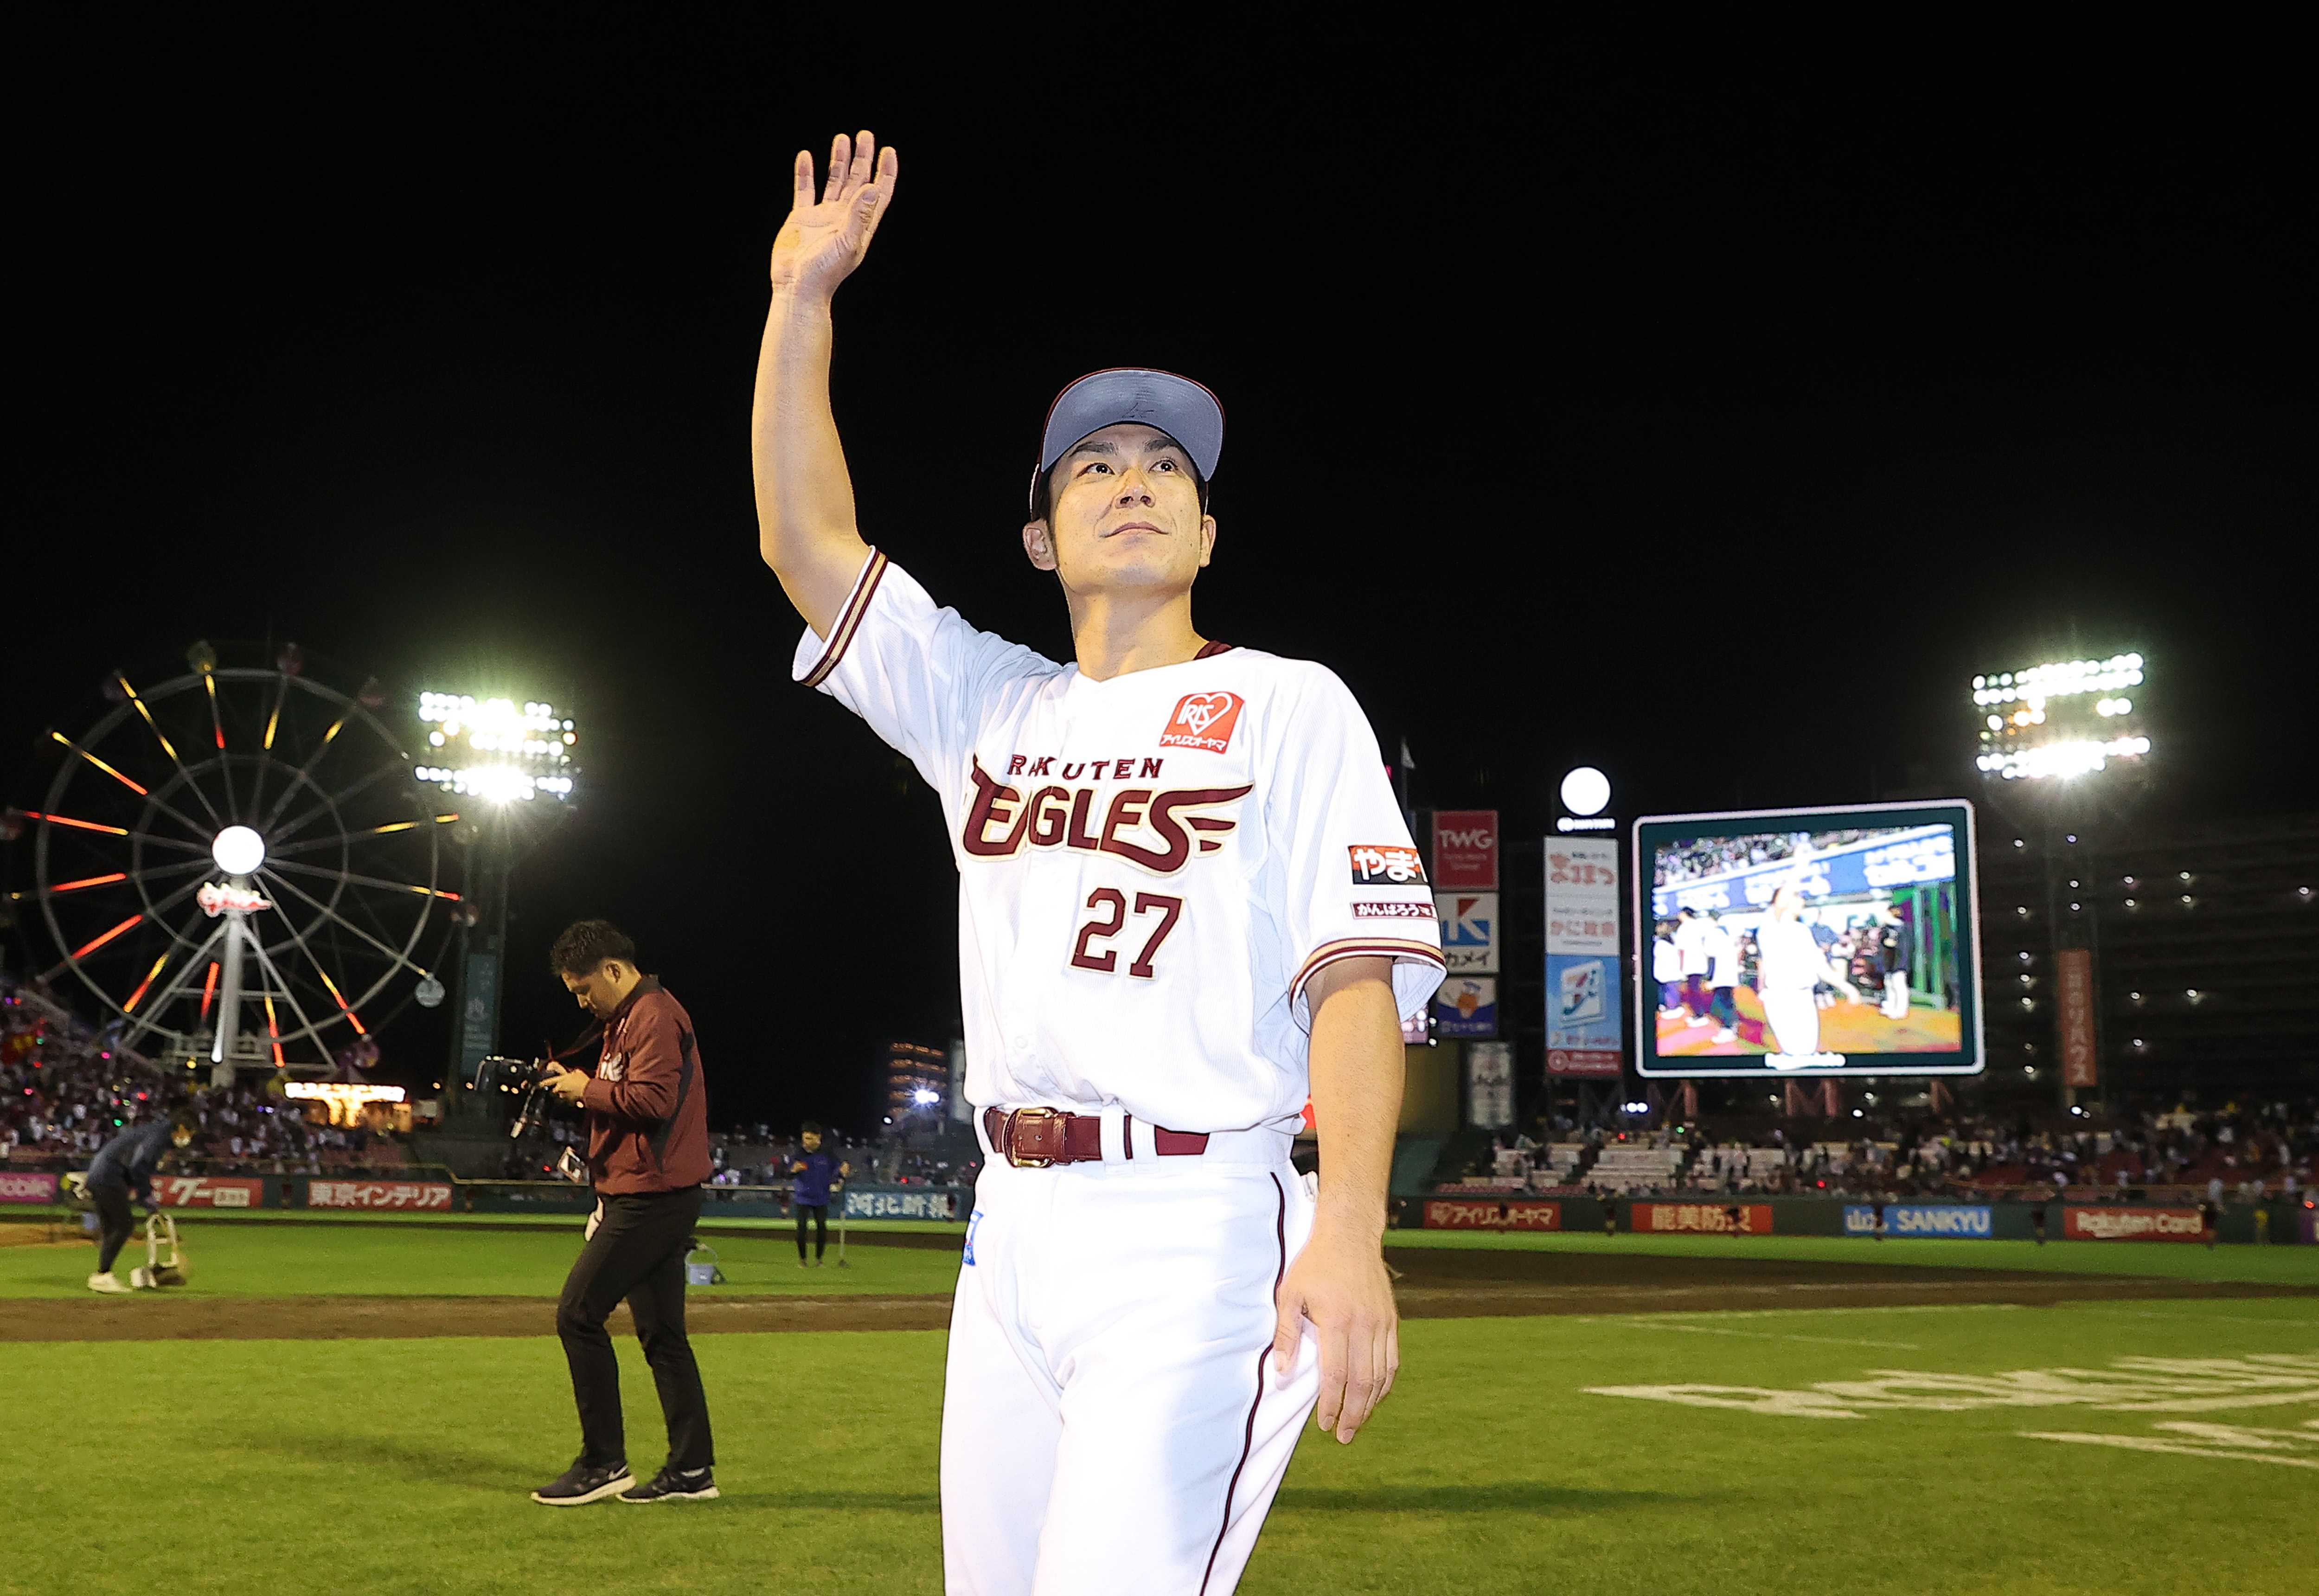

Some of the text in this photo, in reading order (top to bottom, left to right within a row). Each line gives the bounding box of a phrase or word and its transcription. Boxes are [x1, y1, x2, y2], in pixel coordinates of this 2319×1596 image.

[1176, 704, 1214, 725] IRIS
[1160, 734, 1227, 751] アイリスオーヤマ
[1440, 829, 1493, 849] TWG
[1070, 887, 1183, 978] 27
[309, 1182, 451, 1207] 東京インテリア
[1897, 1209, 1990, 1233] SANKYU
[2157, 1212, 2202, 1234] Card
